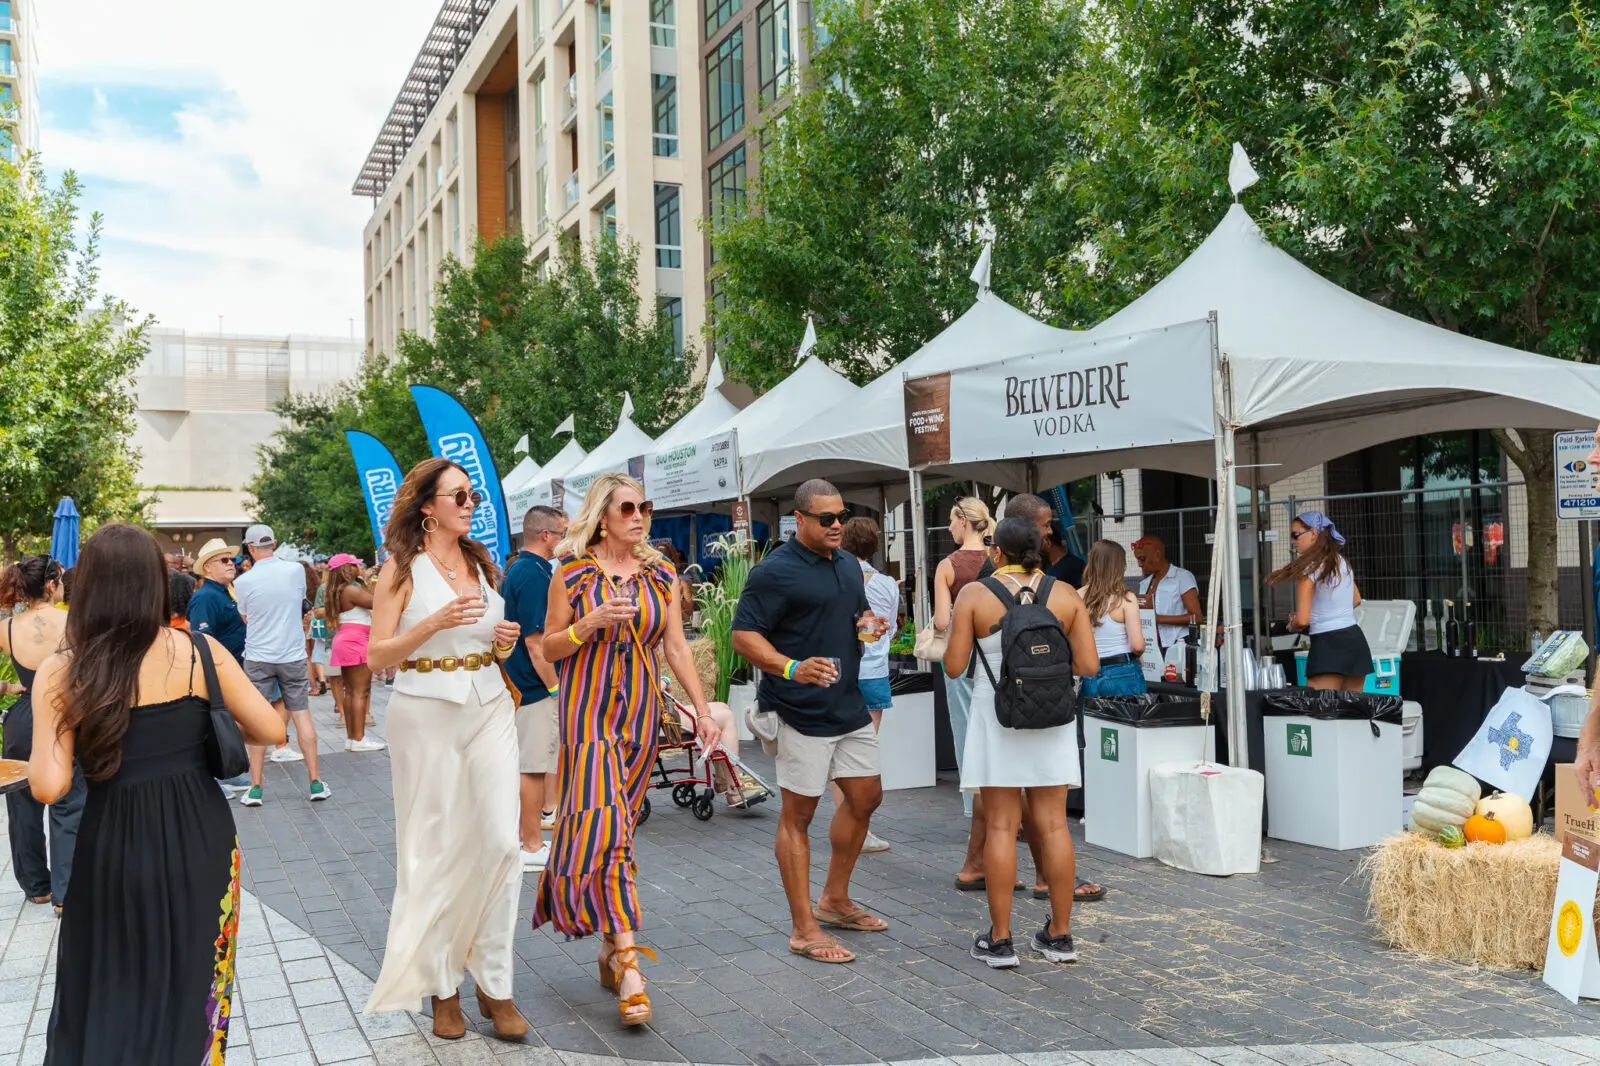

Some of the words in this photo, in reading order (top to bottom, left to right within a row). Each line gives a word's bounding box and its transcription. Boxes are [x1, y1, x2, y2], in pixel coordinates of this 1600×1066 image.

[1005, 362, 1129, 417] BELVEDERE
[914, 424, 940, 435] FESTIVAL
[1033, 412, 1097, 437] VODKA
[1575, 434, 1597, 443] Parkin
[1563, 499, 1597, 507] 471210
